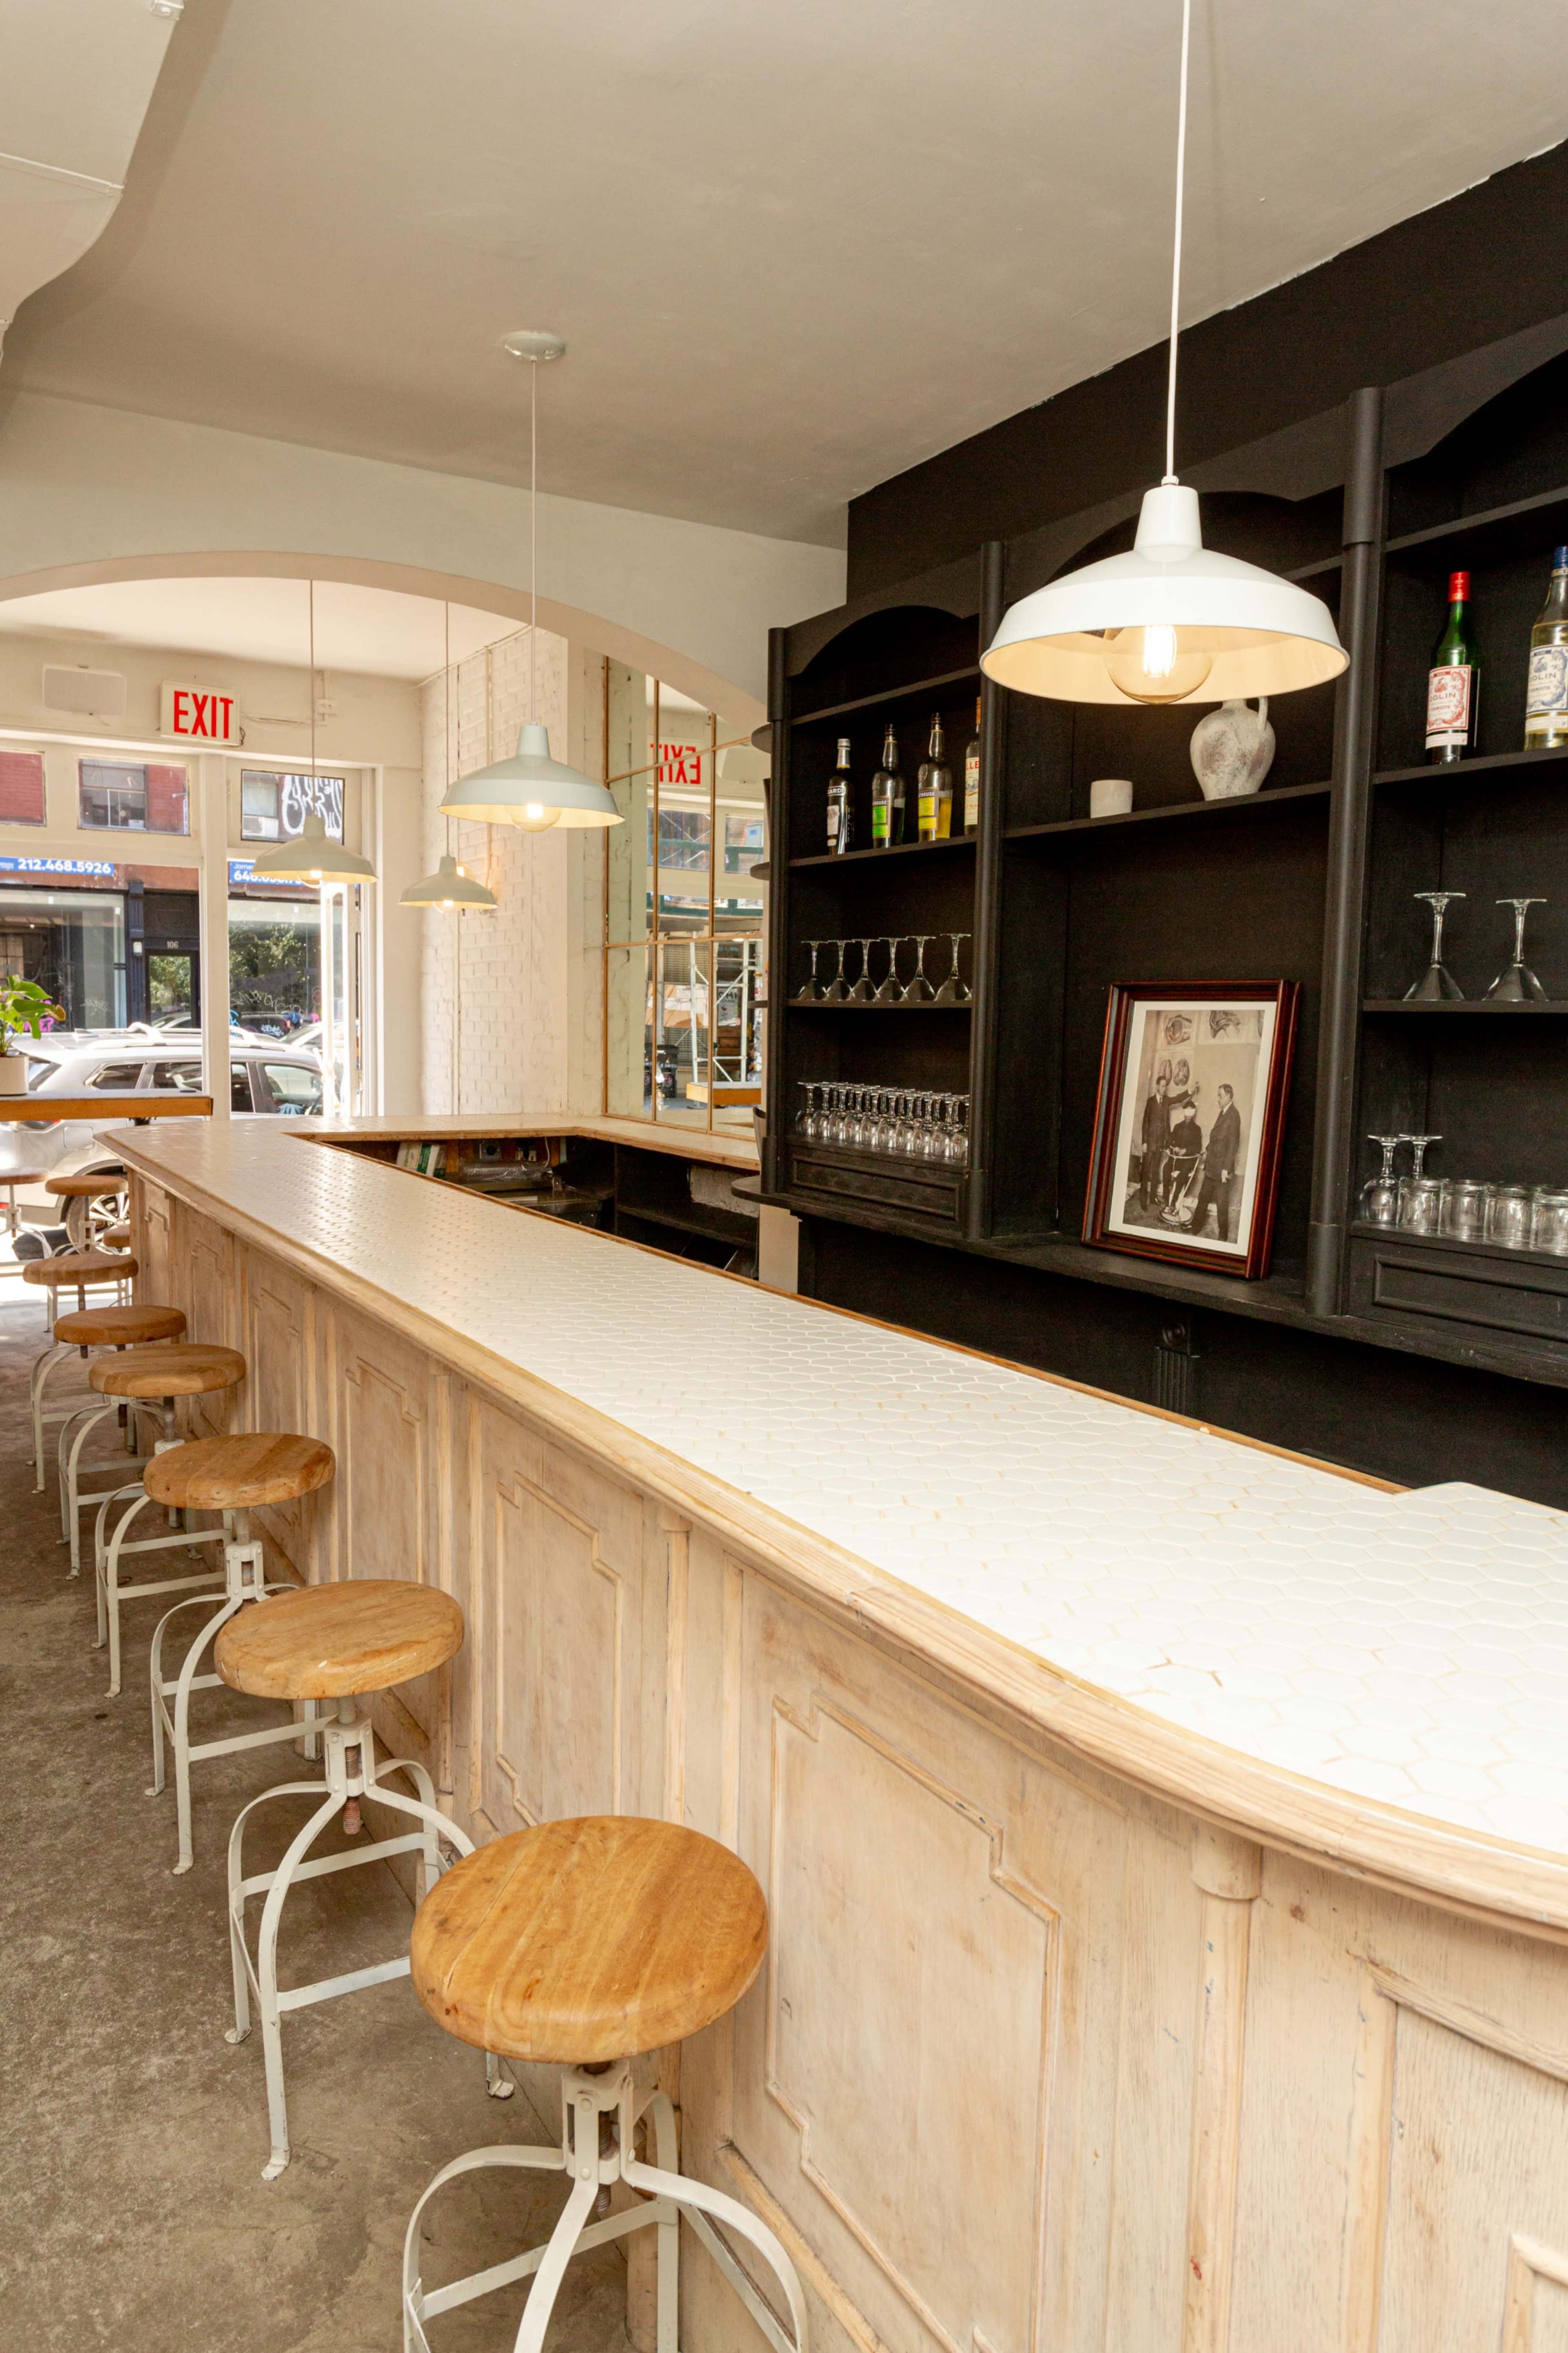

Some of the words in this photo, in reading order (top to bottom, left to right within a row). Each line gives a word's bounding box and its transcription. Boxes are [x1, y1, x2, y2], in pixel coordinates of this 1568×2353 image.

[174, 690, 234, 739] EXIT
[18, 858, 111, 874] 212.468.5926
[167, 941, 178, 949] 106
